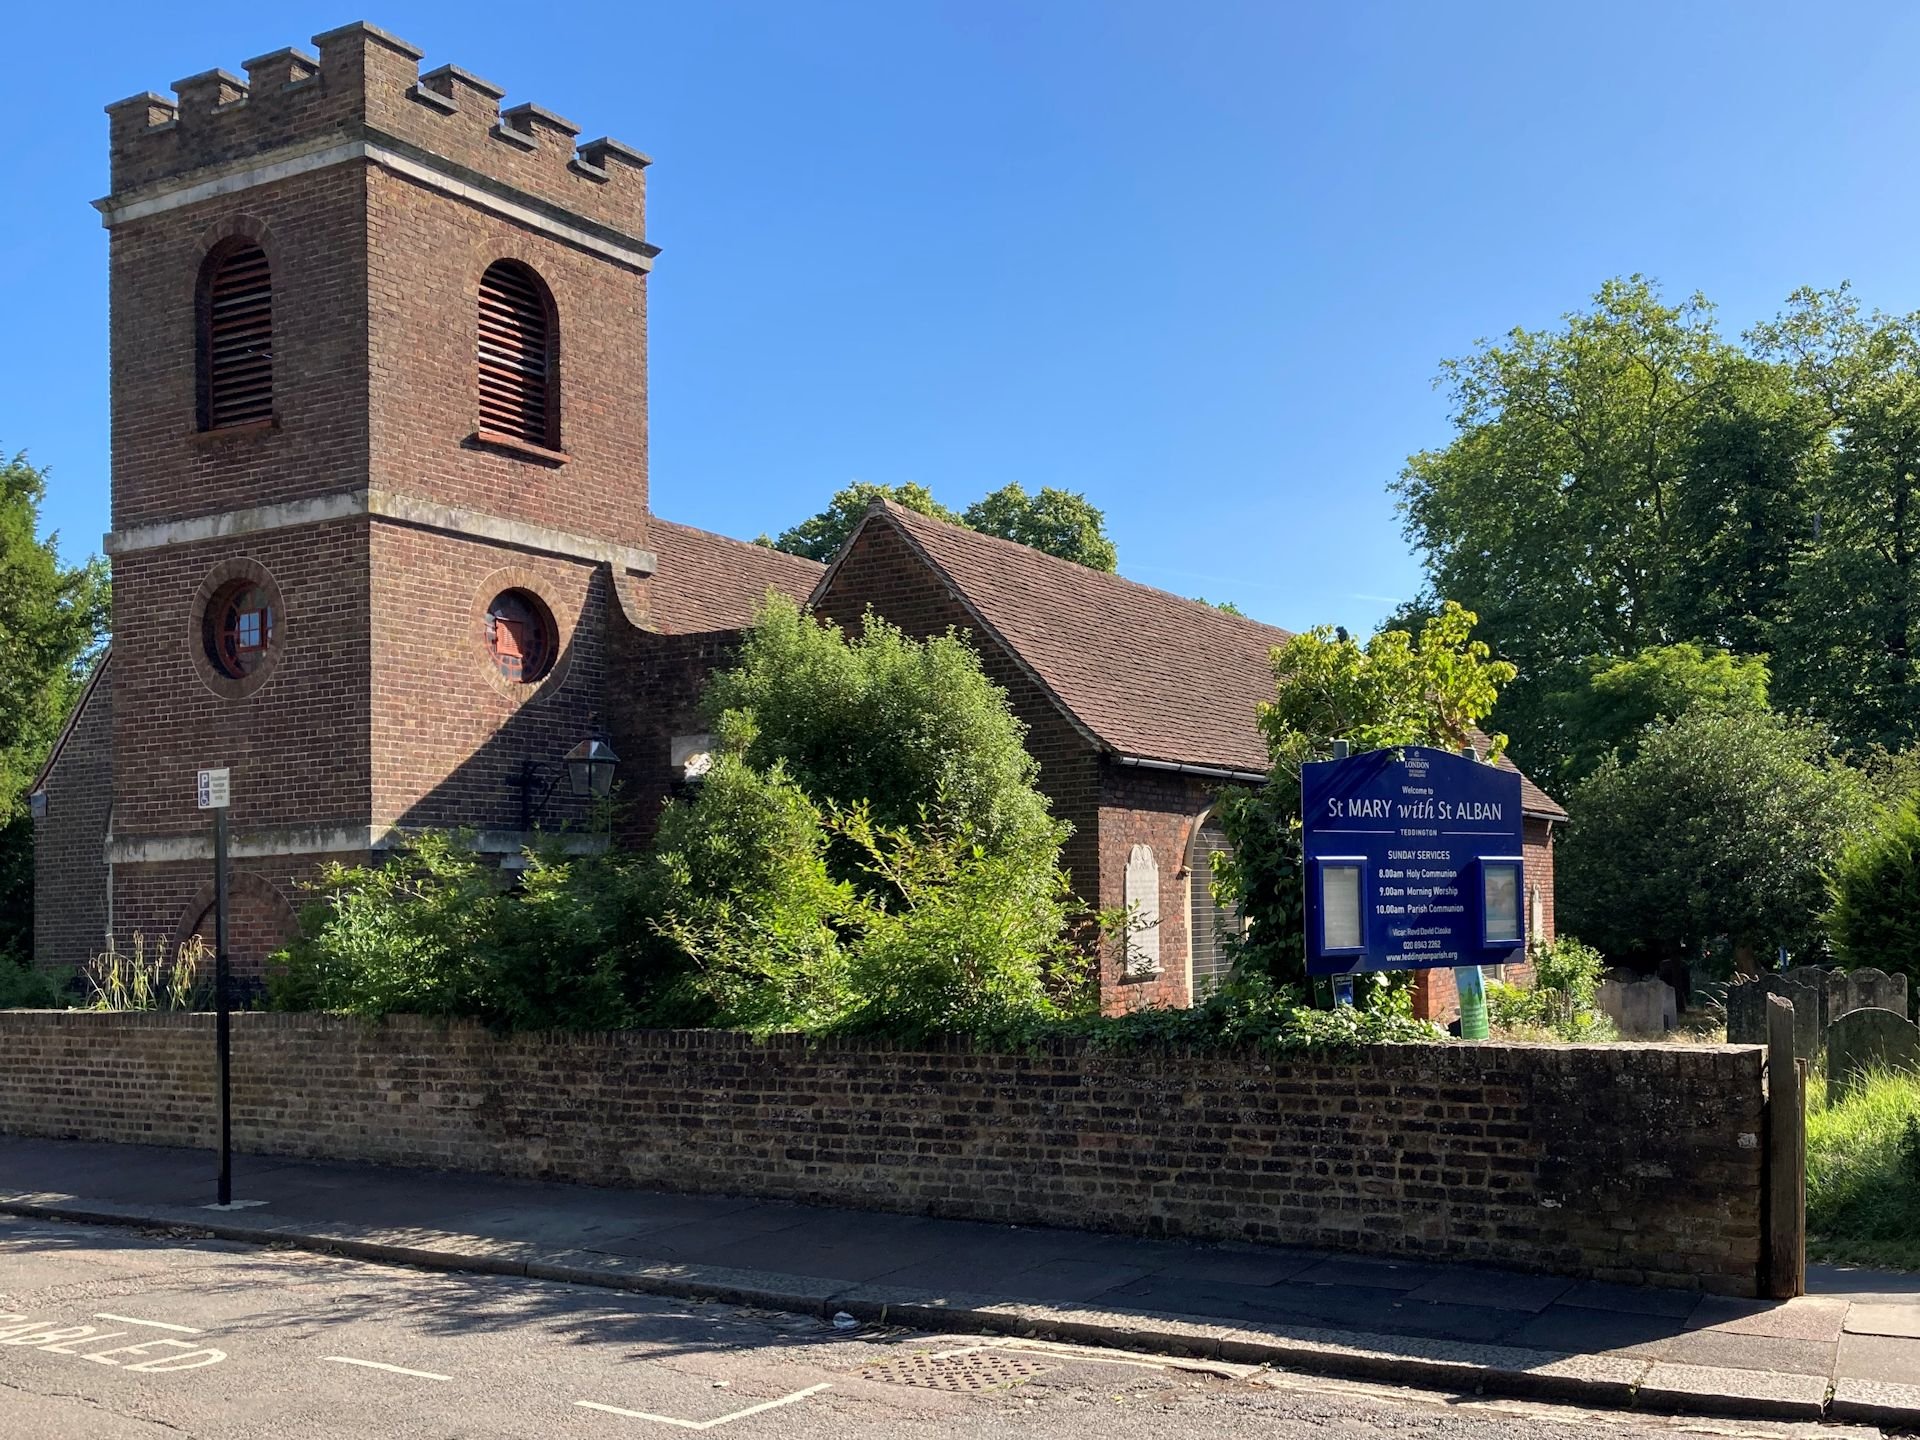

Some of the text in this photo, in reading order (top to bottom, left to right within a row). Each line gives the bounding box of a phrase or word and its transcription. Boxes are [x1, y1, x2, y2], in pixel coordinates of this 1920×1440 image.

[1404, 761, 1430, 769] LONDON
[1402, 786, 1434, 795] Welcome to
[1328, 797, 1502, 821] St MARY with St ALBAN
[1400, 828, 1438, 837] TEDDINGTON
[1388, 850, 1450, 860] SUNDAY SERVICES
[1379, 869, 1457, 879] 8.00am Holy Communion
[1380, 886, 1458, 897] 9.00am Morning Worship
[1376, 904, 1464, 914] 10.00am Parish Communion
[1421, 927, 1435, 935] David
[1403, 941, 1413, 950] 020
[1386, 951, 1458, 962] www.teddingtonparish.org
